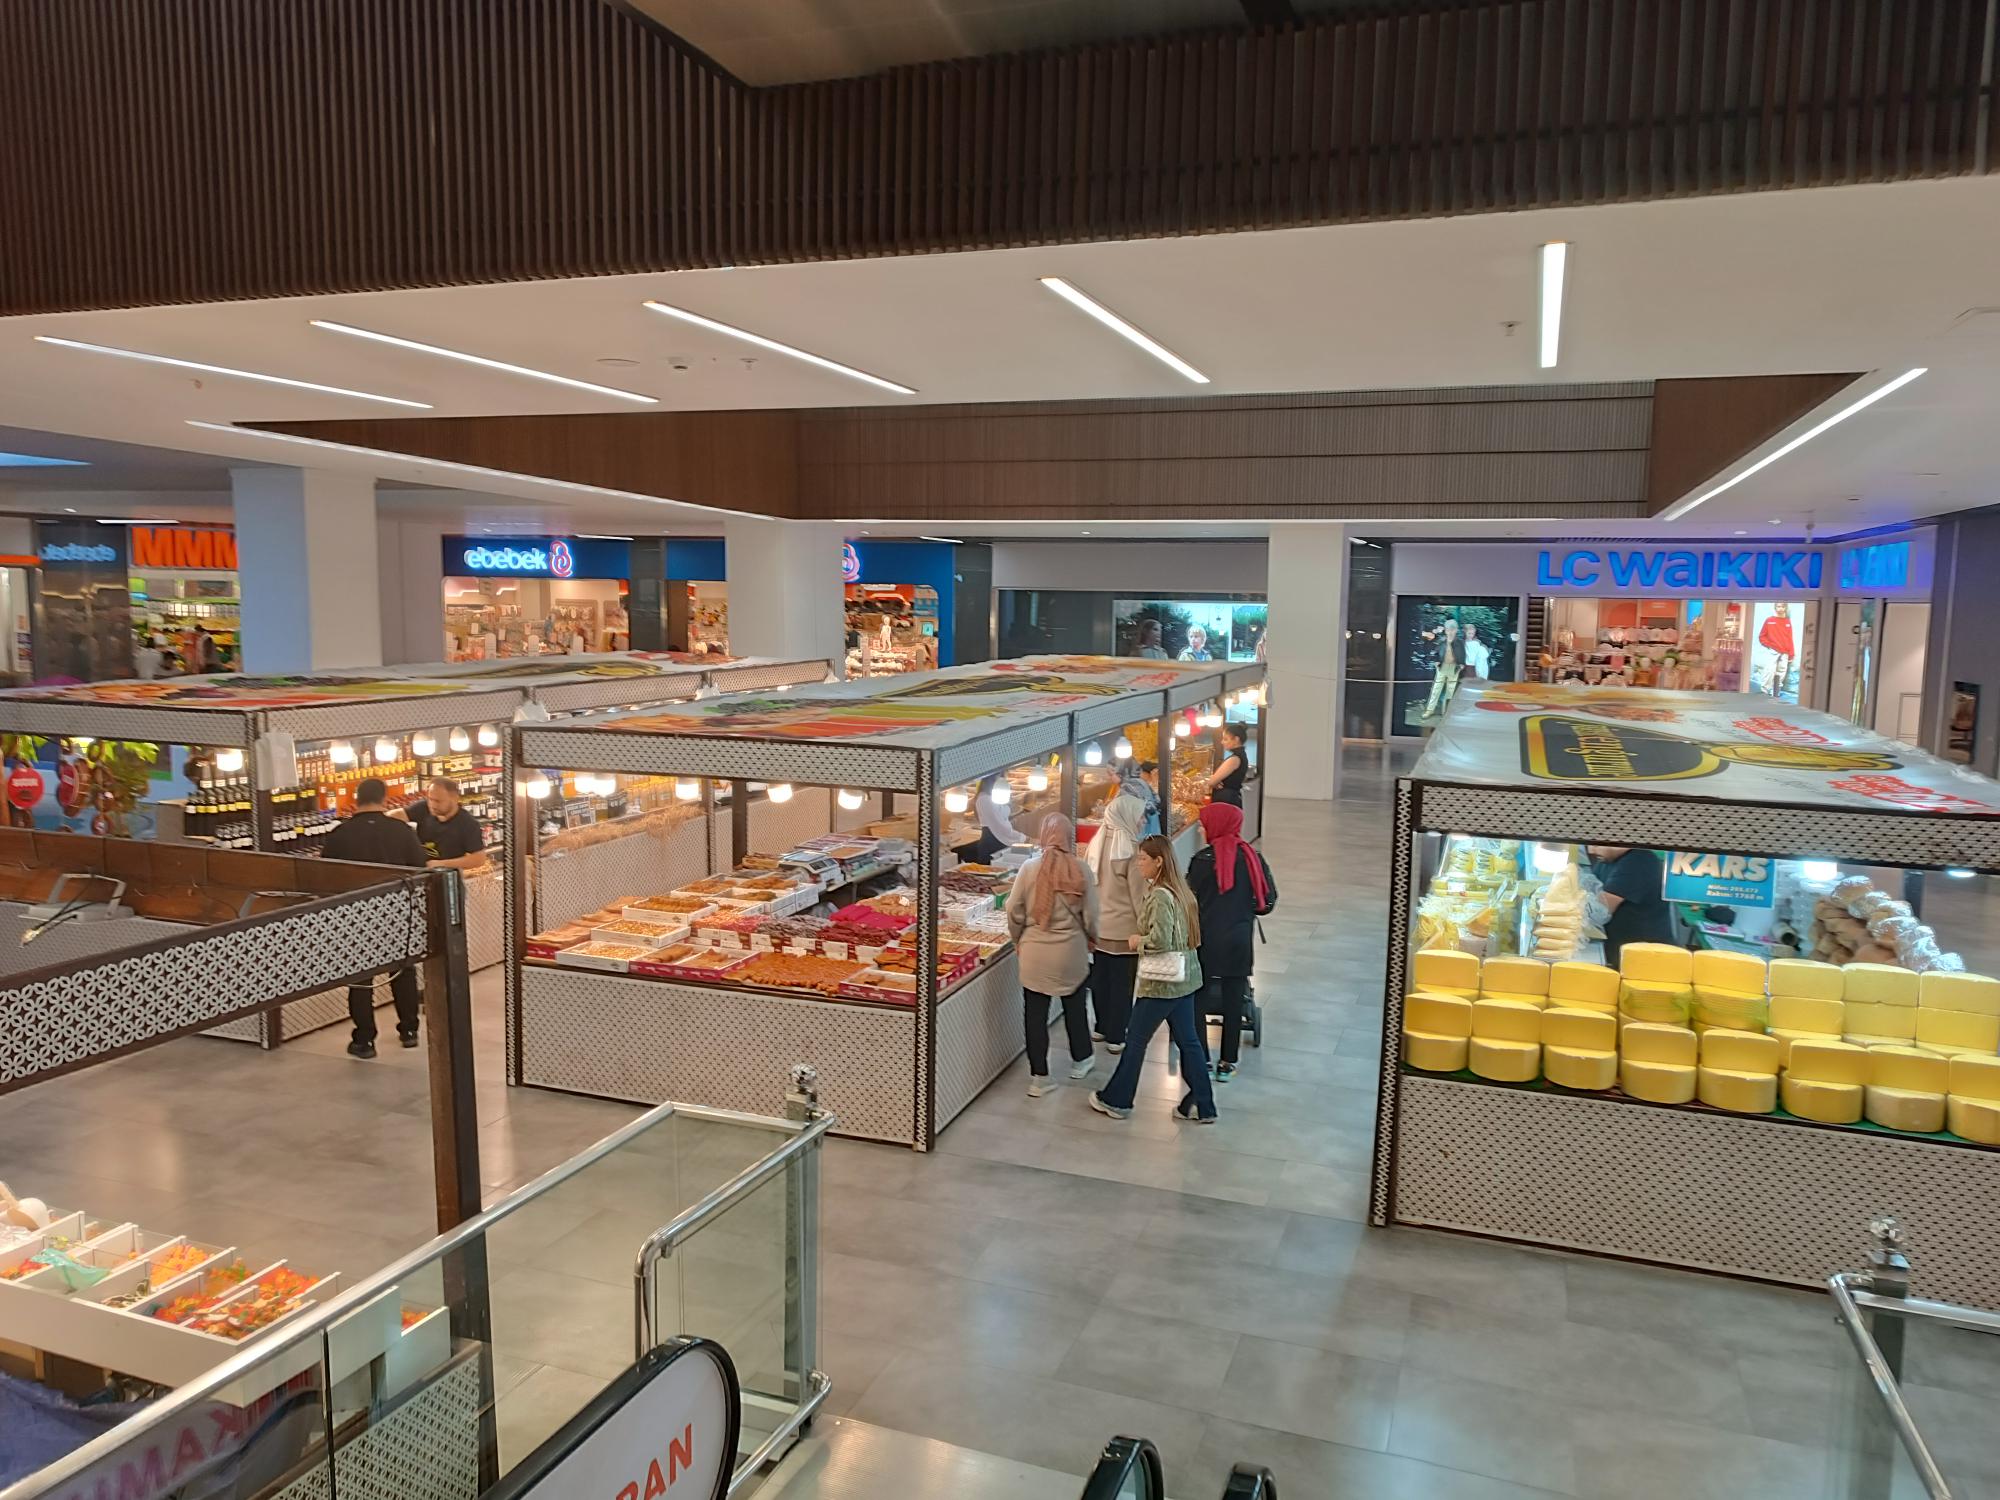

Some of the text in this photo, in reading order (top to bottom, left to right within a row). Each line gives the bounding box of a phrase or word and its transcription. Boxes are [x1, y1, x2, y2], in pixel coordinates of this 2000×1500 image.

[465, 547, 548, 570] ebebek
[1538, 551, 1600, 587] LC
[1671, 852, 1768, 882] KARS
